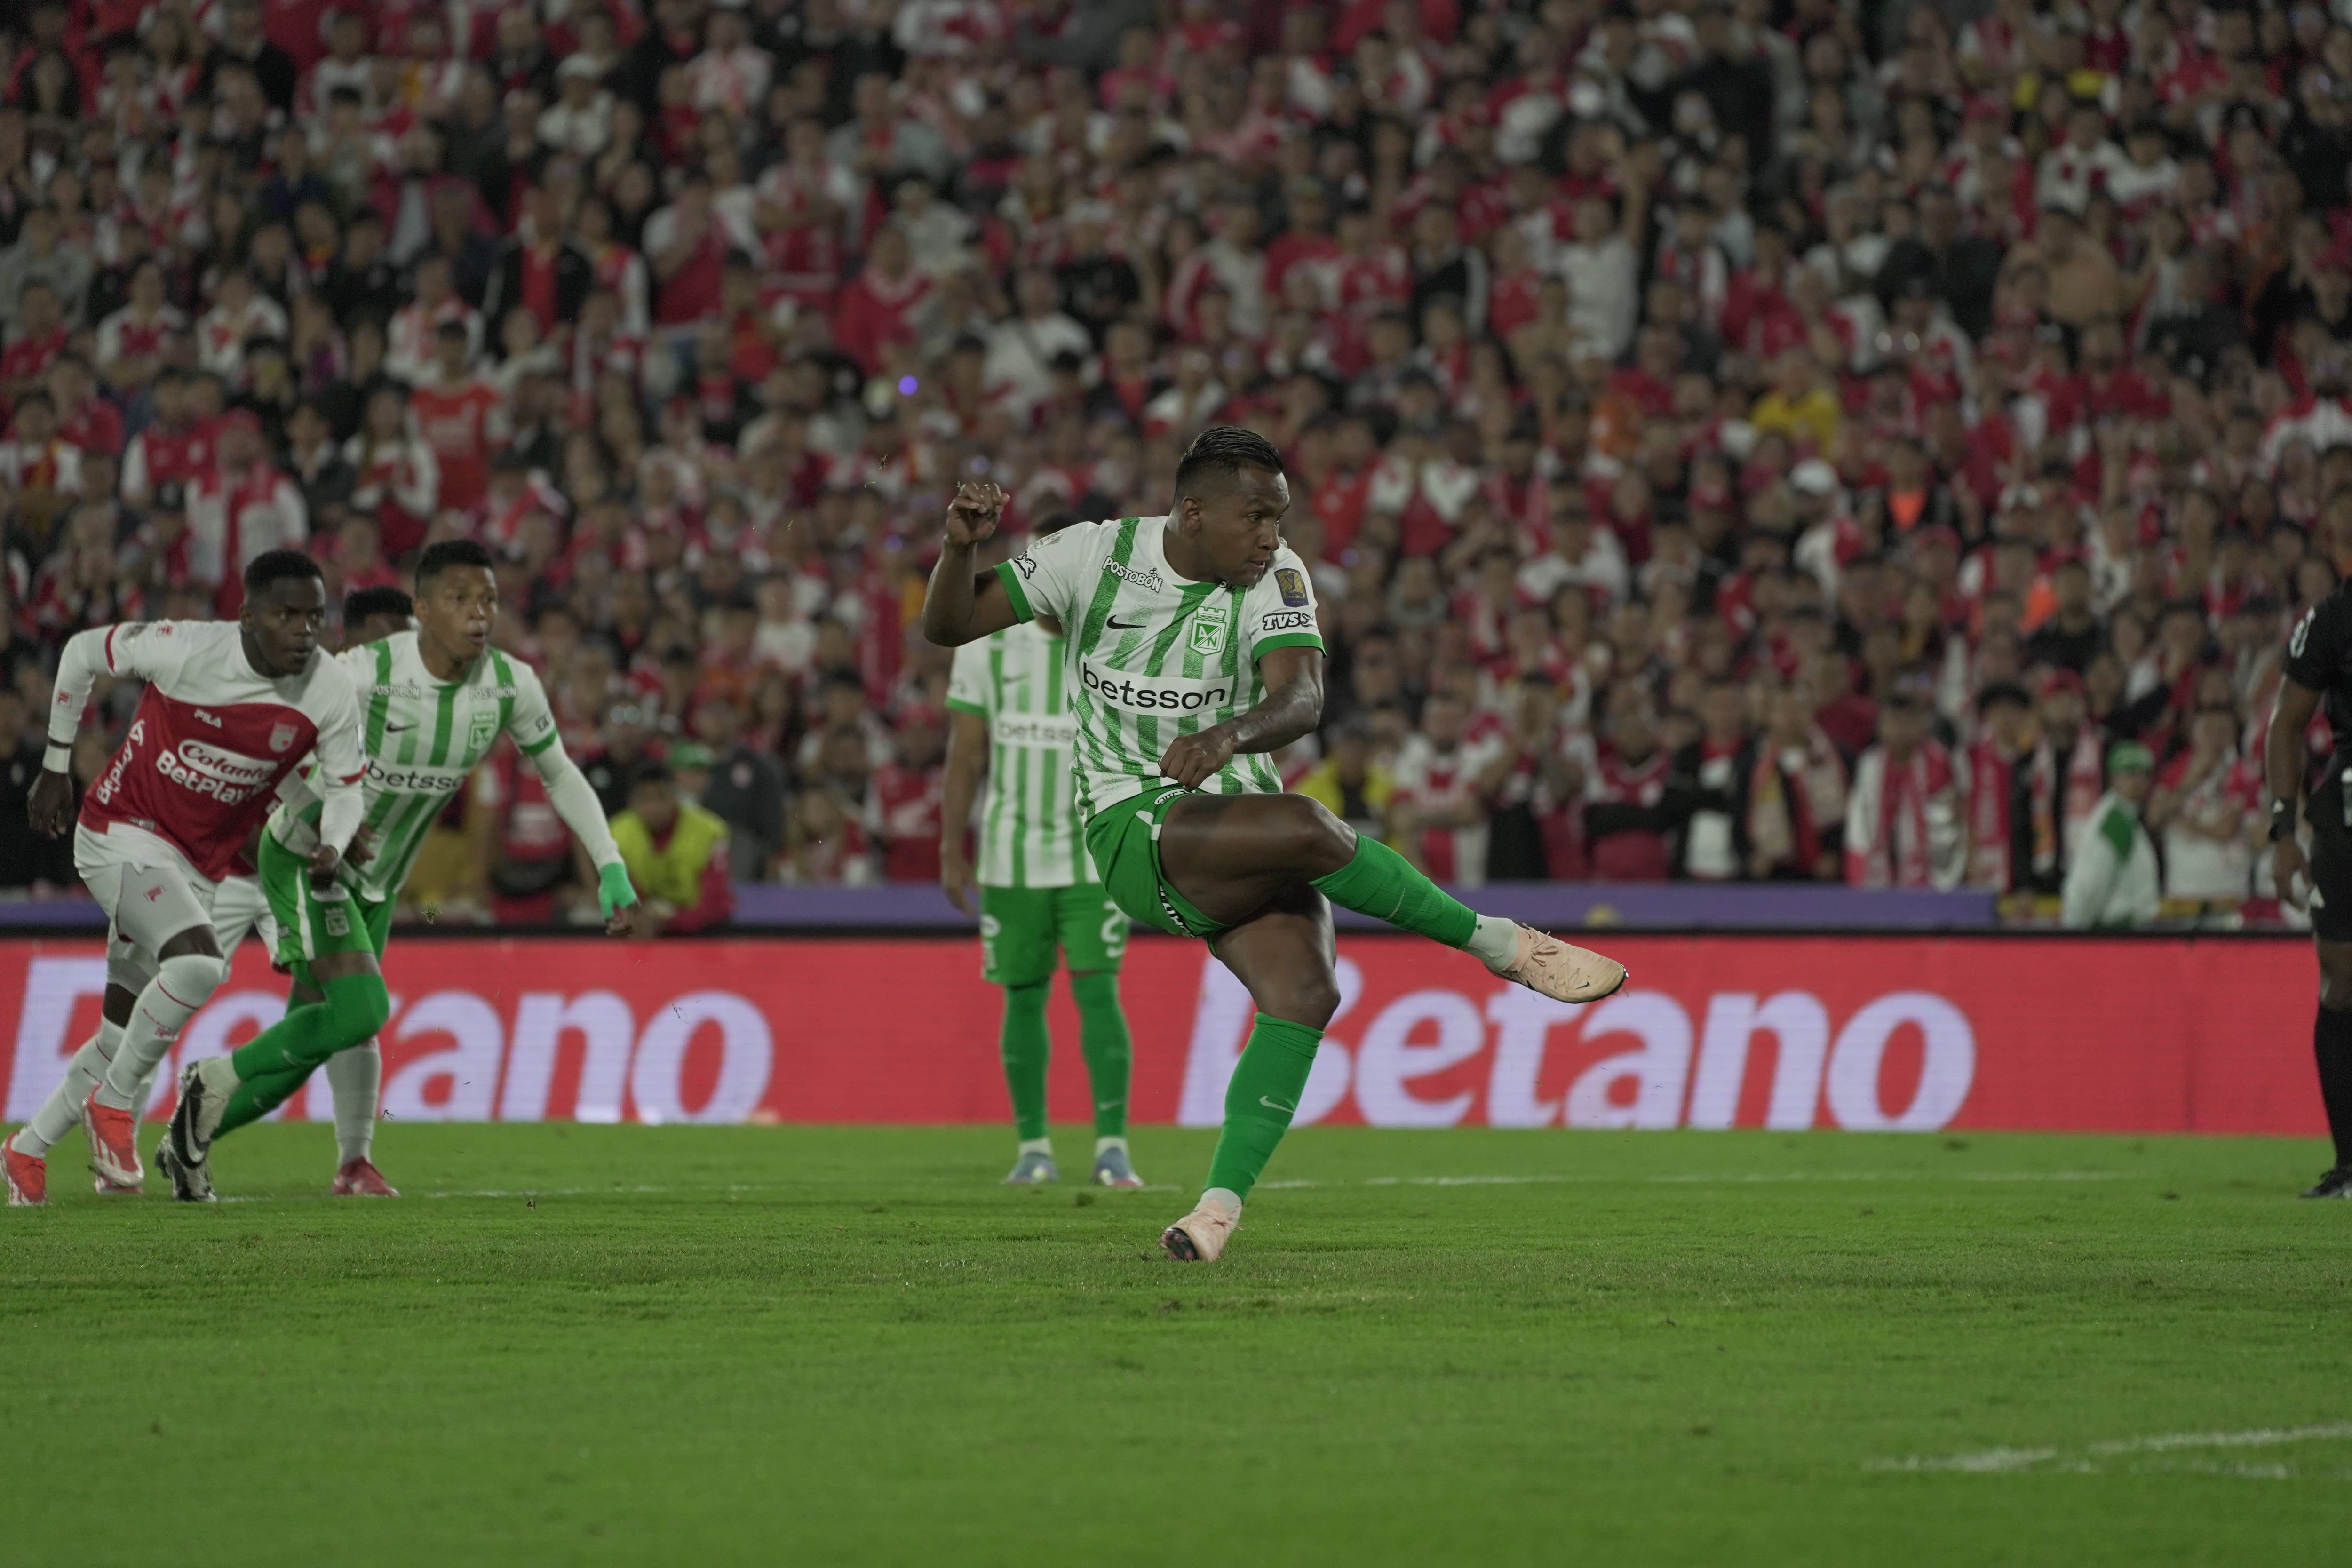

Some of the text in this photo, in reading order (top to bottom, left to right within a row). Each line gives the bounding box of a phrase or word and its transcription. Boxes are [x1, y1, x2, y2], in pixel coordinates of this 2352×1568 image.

[1262, 612, 1300, 630] TVS
[1083, 661, 1225, 709] betsson
[193, 708, 222, 728] FILA
[1176, 956, 1976, 1132] Betano
